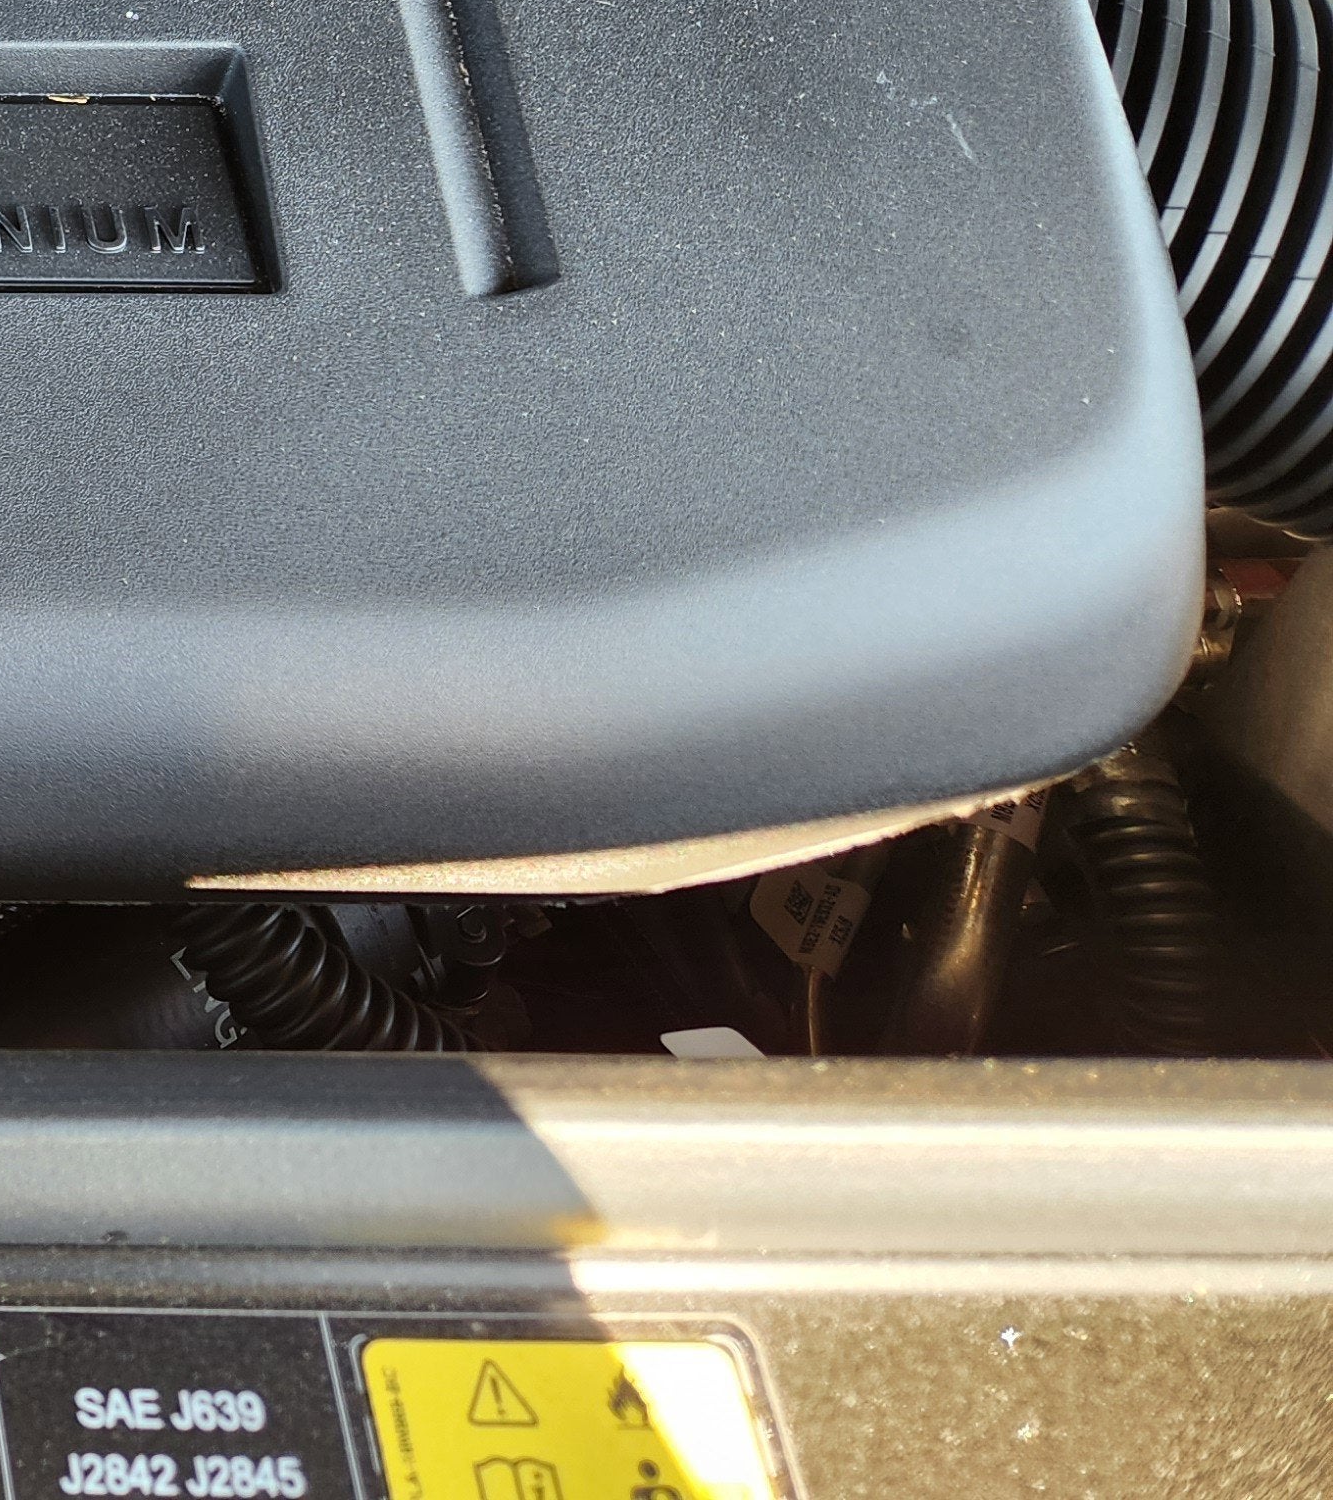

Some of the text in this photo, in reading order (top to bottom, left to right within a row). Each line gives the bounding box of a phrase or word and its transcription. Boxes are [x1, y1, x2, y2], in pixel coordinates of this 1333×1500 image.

[74, 1387, 266, 1432] SAE J639
[59, 1452, 308, 1499] J2842 J2845
